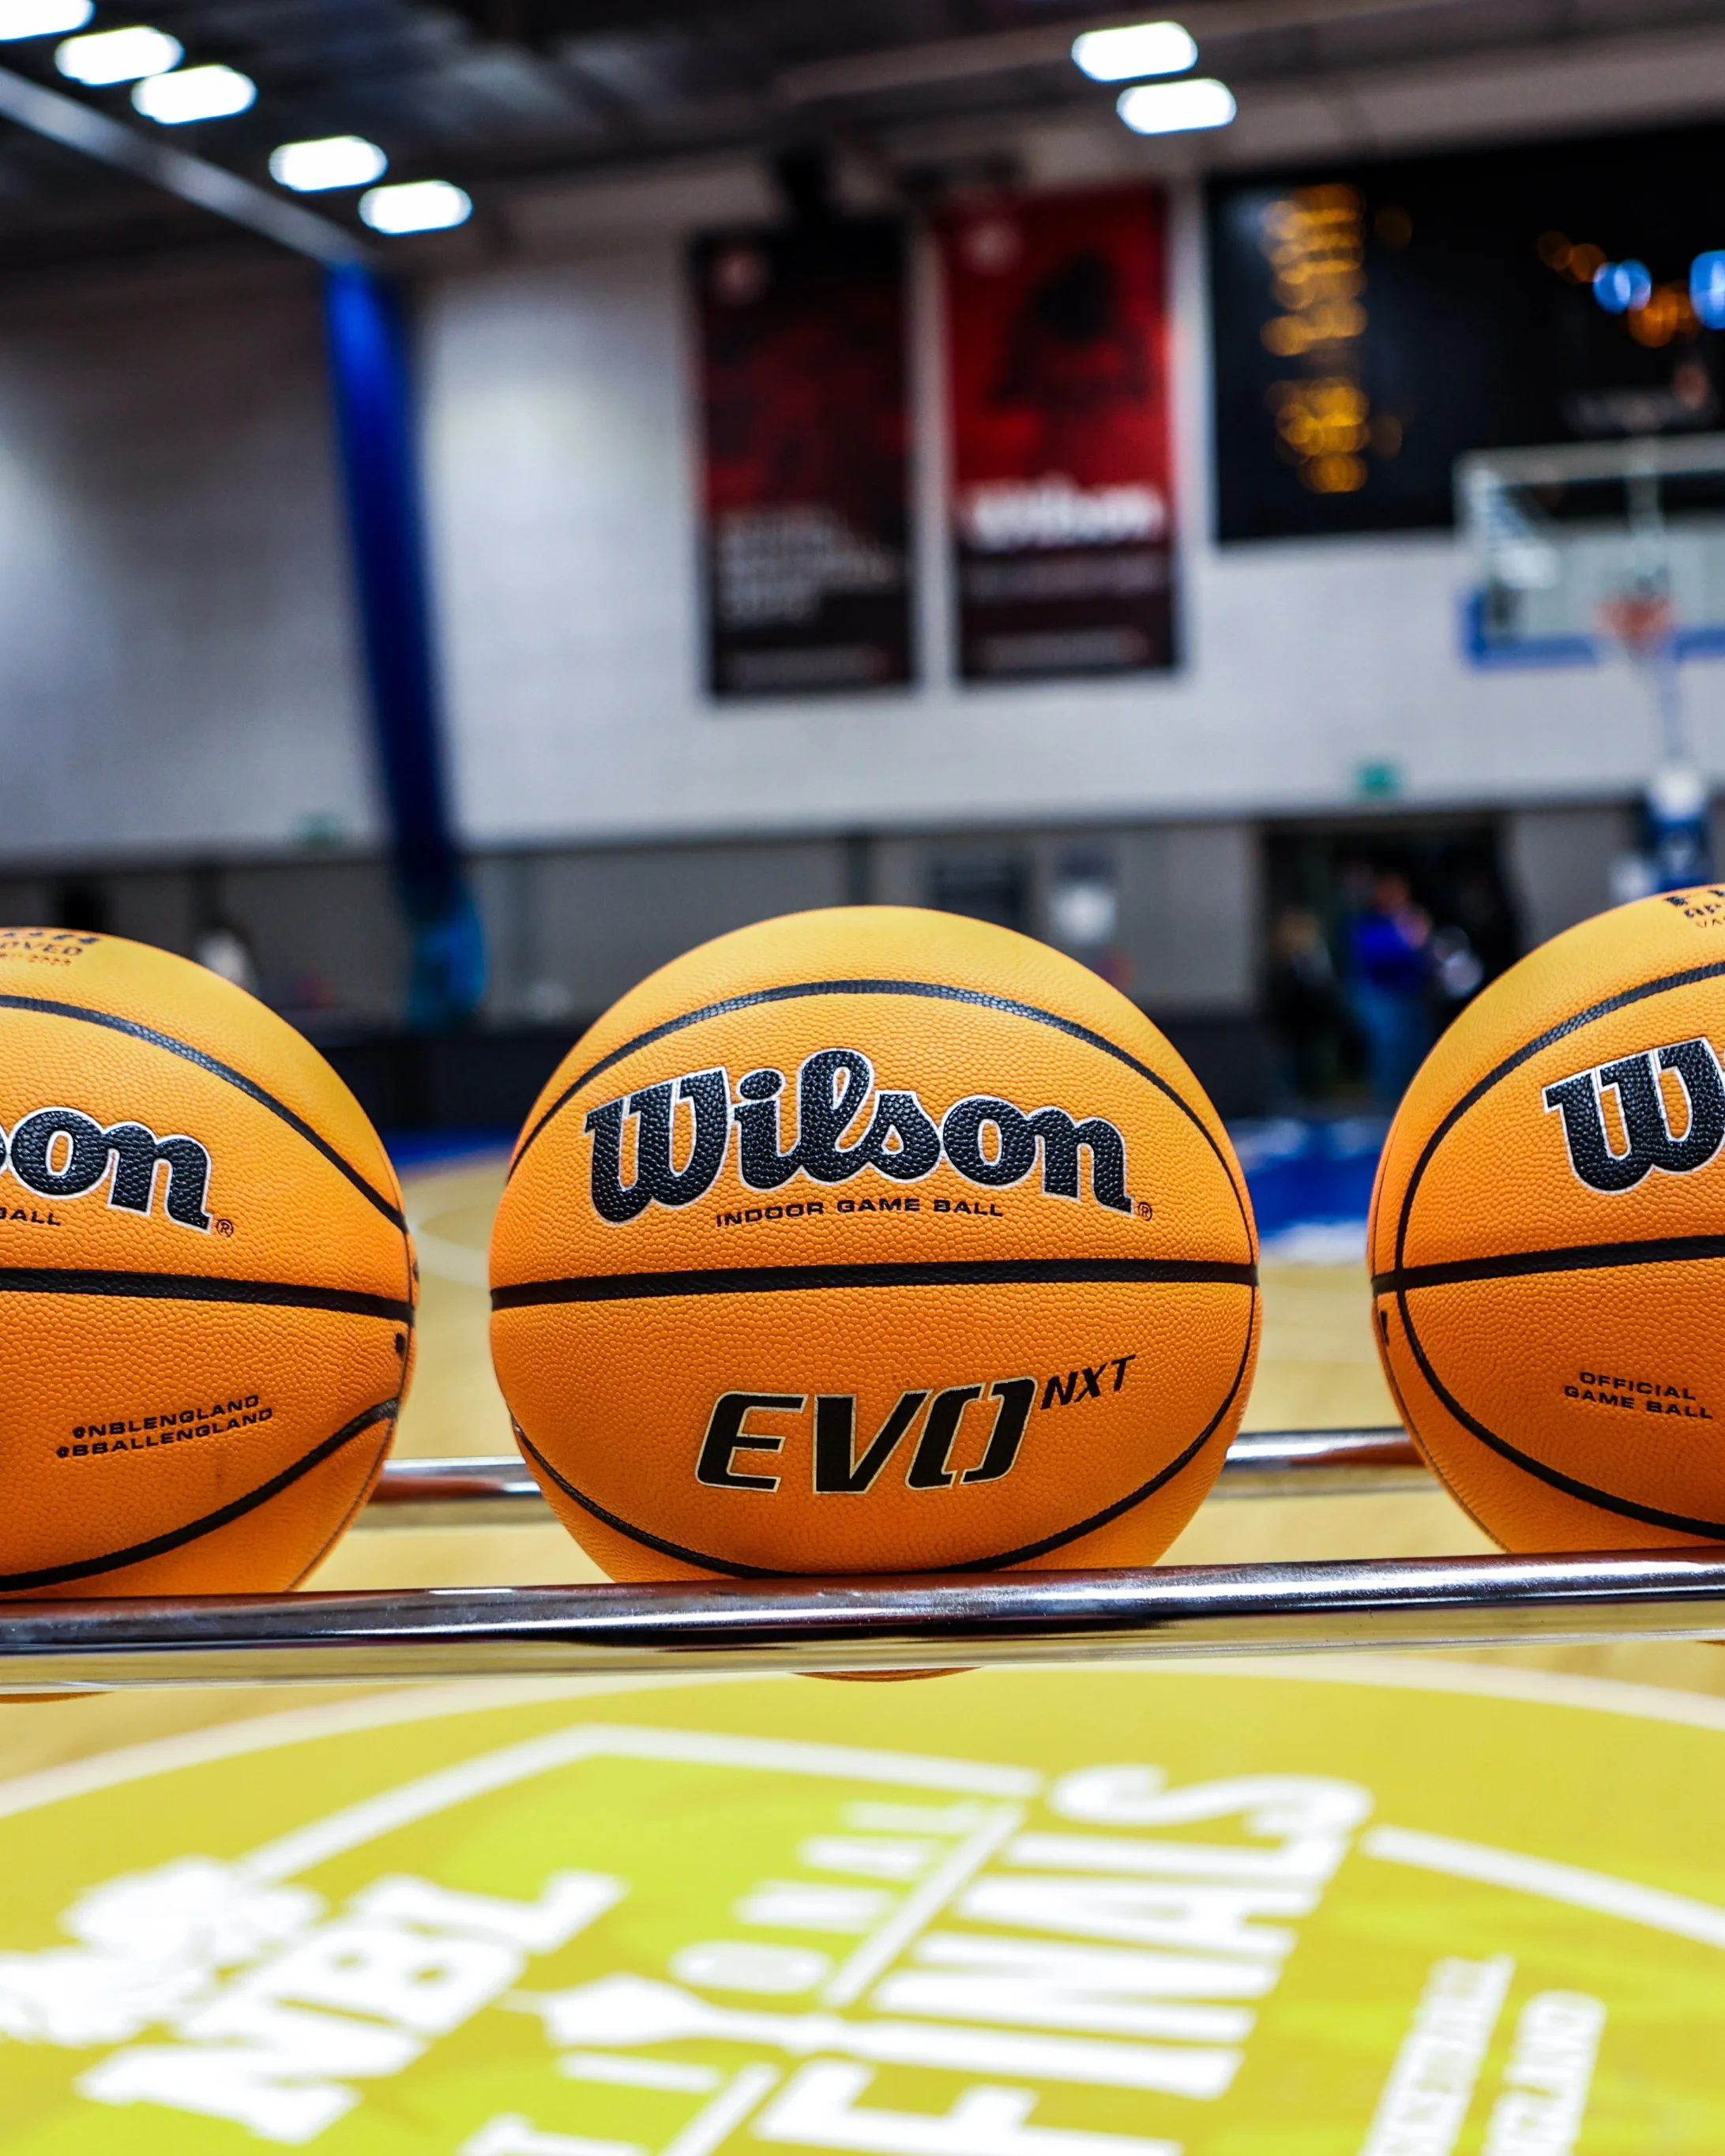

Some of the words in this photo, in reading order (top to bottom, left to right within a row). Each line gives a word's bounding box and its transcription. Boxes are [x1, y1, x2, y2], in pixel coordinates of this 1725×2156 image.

[583, 1048, 1133, 1223] Wilson
[1542, 1036, 1725, 1195] W
[0, 1106, 212, 1234] on
[716, 1201, 825, 1228] INDOOR
[836, 1197, 921, 1214] GAME
[934, 1199, 1005, 1218] BALL
[72, 1394, 259, 1440] @NBLENGLAND
[695, 1375, 1039, 1494] EVO
[1039, 1354, 1136, 1410] NXT
[1564, 1385, 1635, 1409] GAME
[1646, 1400, 1714, 1419] BALL
[1580, 1371, 1697, 1401] OFFICIAL
[55, 1407, 273, 1459] @BBALLENGLAND
[75, 1867, 629, 2145] NBL
